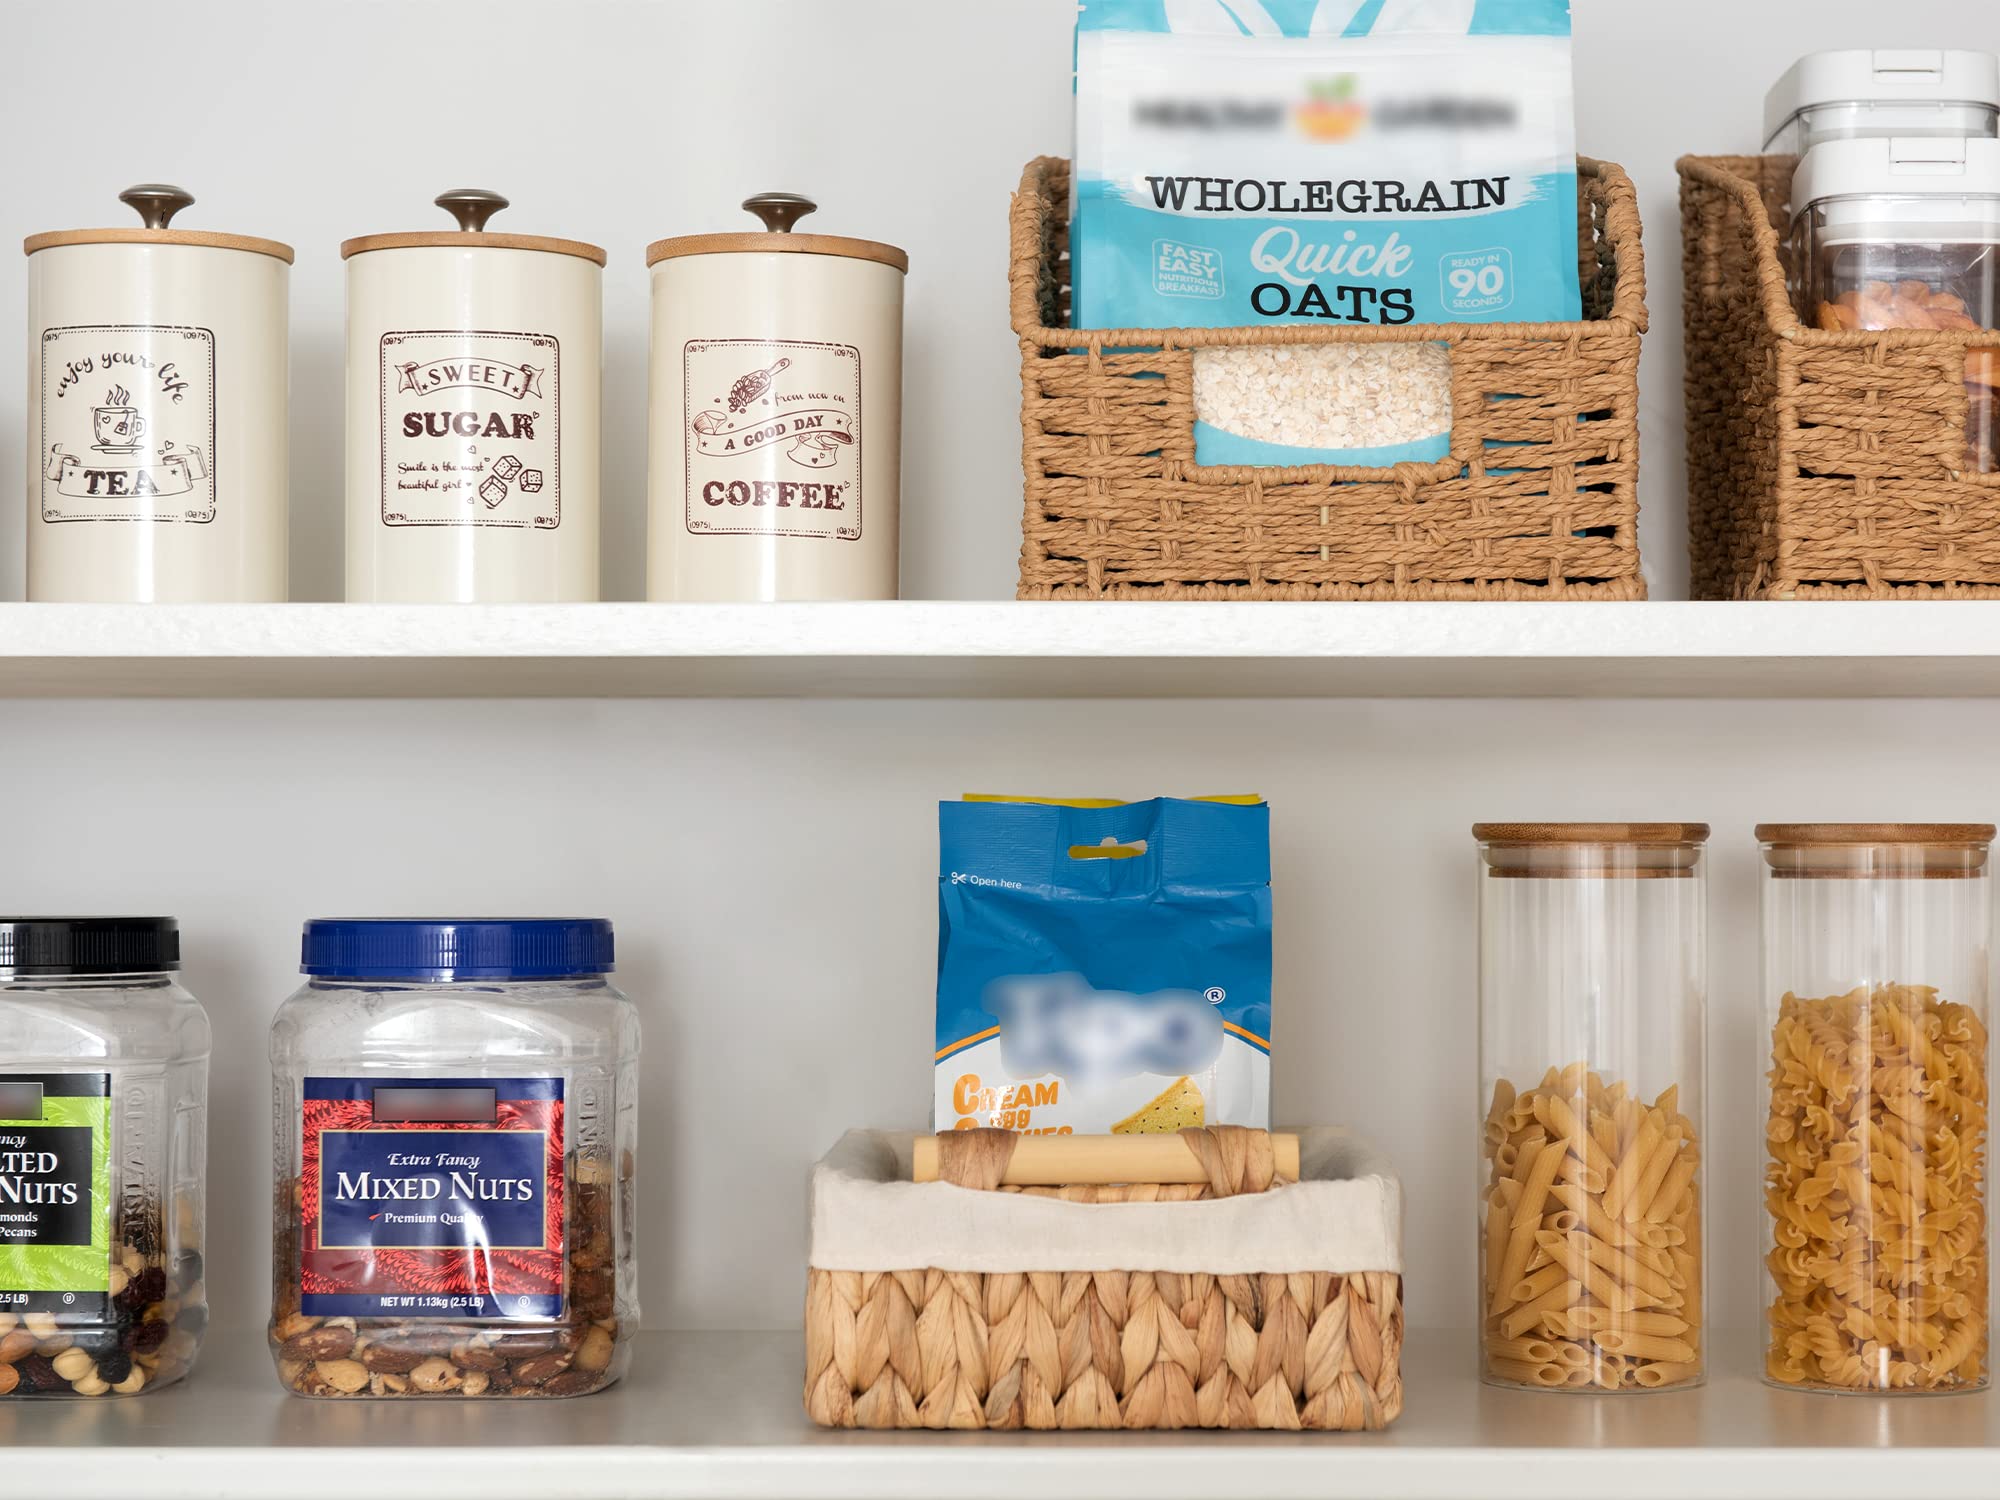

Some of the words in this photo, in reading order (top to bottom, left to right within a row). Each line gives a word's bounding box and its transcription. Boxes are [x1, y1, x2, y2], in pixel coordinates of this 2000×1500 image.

[1144, 176, 1510, 213] WHOLEGRAIN
[1162, 243, 1214, 265] FAST
[1250, 226, 1414, 286] Quick
[1451, 255, 1486, 268] READY
[1487, 253, 1500, 264] IN
[1159, 255, 1217, 279] EASY
[1158, 272, 1219, 288] NUTRITIOUS
[1158, 281, 1219, 296] BREAKFAST
[1449, 265, 1504, 297] 90
[1250, 282, 1415, 326] OATS
[1452, 295, 1504, 308] SECONDS
[57, 356, 94, 398] enjoy
[101, 351, 155, 369] your
[158, 363, 189, 405] life
[428, 364, 515, 387] SWEET
[774, 391, 805, 407] from
[808, 392, 829, 400] now
[833, 394, 846, 404] on
[403, 411, 535, 440] SUGAR
[724, 438, 736, 450] A
[743, 422, 786, 447] GOOD
[793, 415, 824, 431] DAY
[397, 461, 428, 475] Smile
[431, 463, 439, 472] is
[442, 461, 458, 473] the
[460, 461, 484, 473] most
[83, 469, 160, 496] TEA
[397, 479, 439, 492] beautiful
[442, 479, 462, 492] girl
[702, 480, 845, 511] COFFEE
[970, 875, 997, 886] Open
[1000, 878, 1022, 889] here
[0, 1152, 58, 1174] TED
[387, 1153, 432, 1166] Extra
[435, 1153, 482, 1169] Fancy
[0, 1174, 78, 1205] NUTS
[335, 1171, 441, 1201] MIXED
[448, 1171, 533, 1201] NUTS
[384, 1212, 437, 1224] Premium
[440, 1212, 484, 1226] Quay
[0, 1226, 38, 1238] Pecans
[13, 1293, 29, 1306] LB)
[380, 1296, 399, 1307] NET
[400, 1296, 415, 1307] WT
[417, 1296, 448, 1308] 1.13kg
[450, 1296, 467, 1308] (2.5
[469, 1296, 485, 1308] LB)
